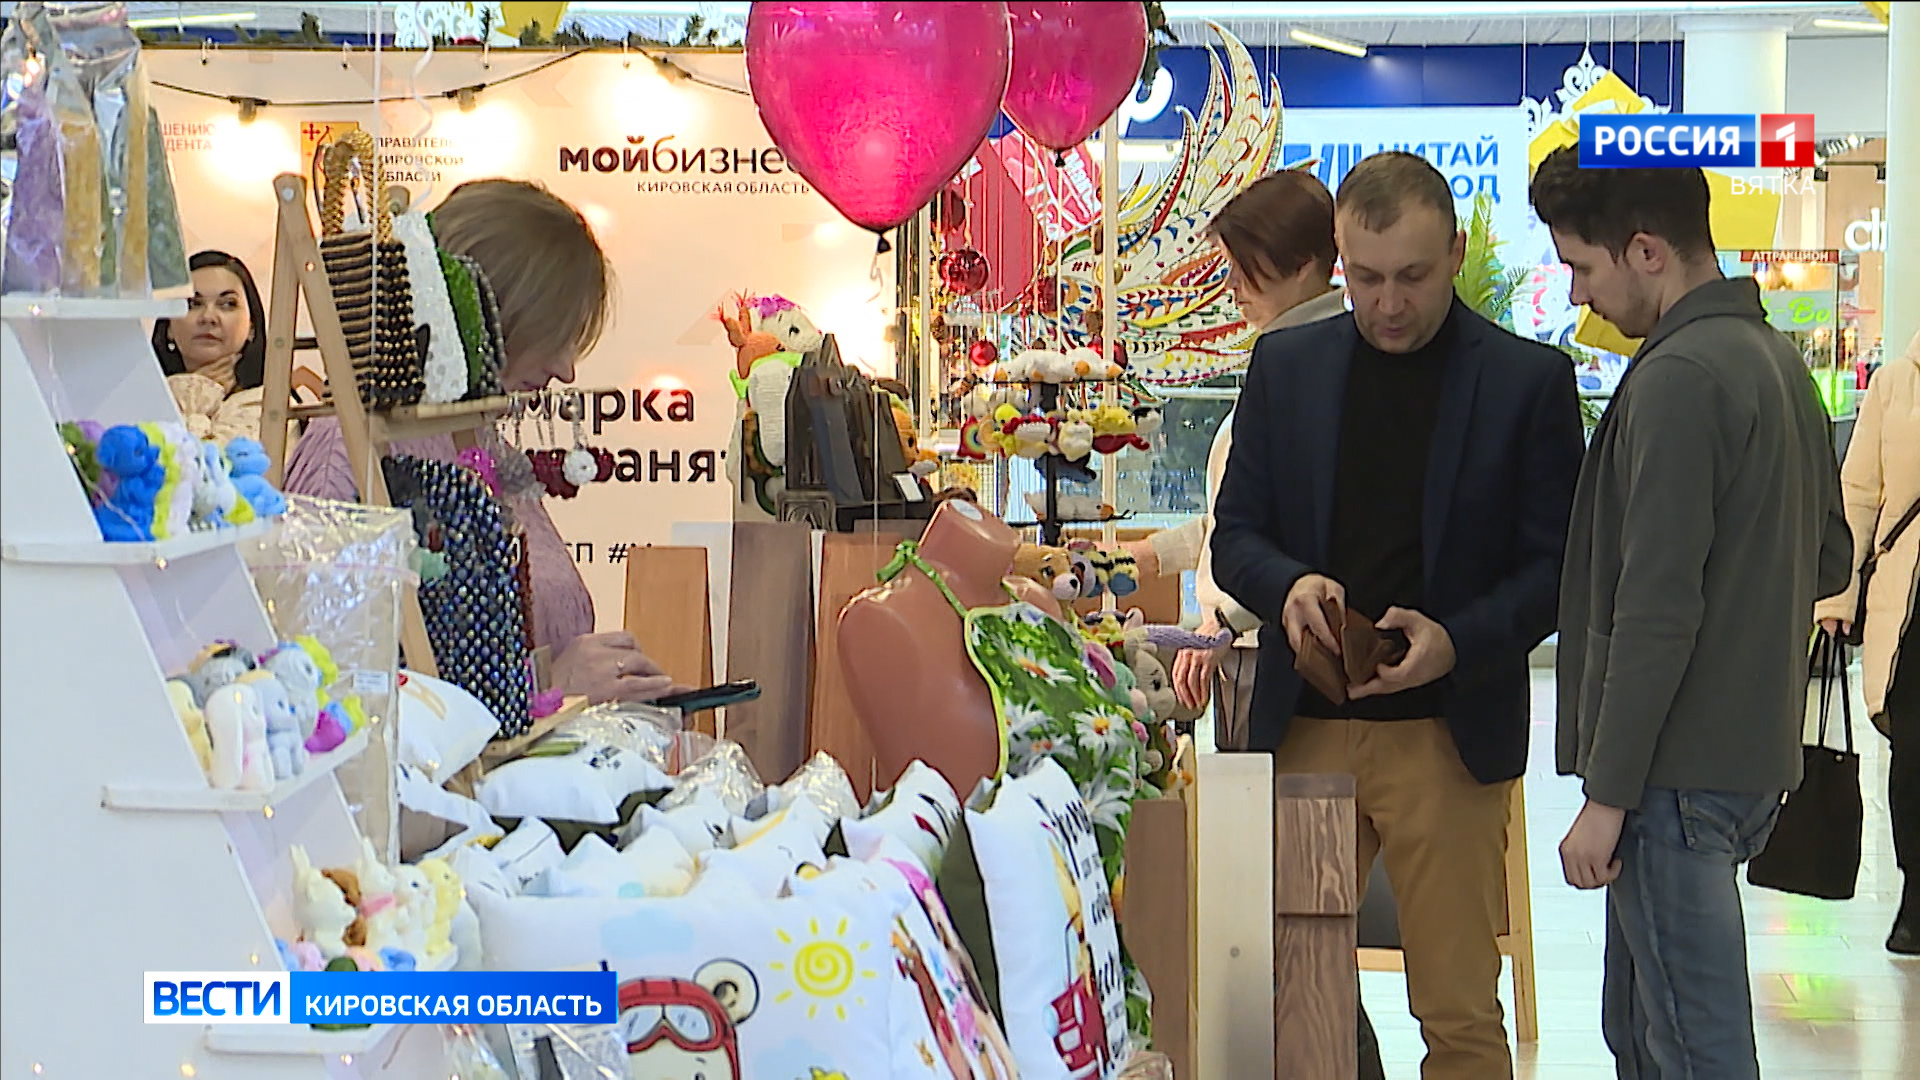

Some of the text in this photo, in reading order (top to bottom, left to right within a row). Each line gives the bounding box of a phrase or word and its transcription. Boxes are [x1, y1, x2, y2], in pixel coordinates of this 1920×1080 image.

[377, 137, 453, 148] ПРАВИТЕЛ
[385, 171, 441, 182] БЛАСИ
[637, 181, 810, 194] КИРОВСКАЯ ОБЛАСТЬ
[1448, 174, 1500, 204] ОД
[1752, 251, 1829, 262] АТТРАКЦИОН
